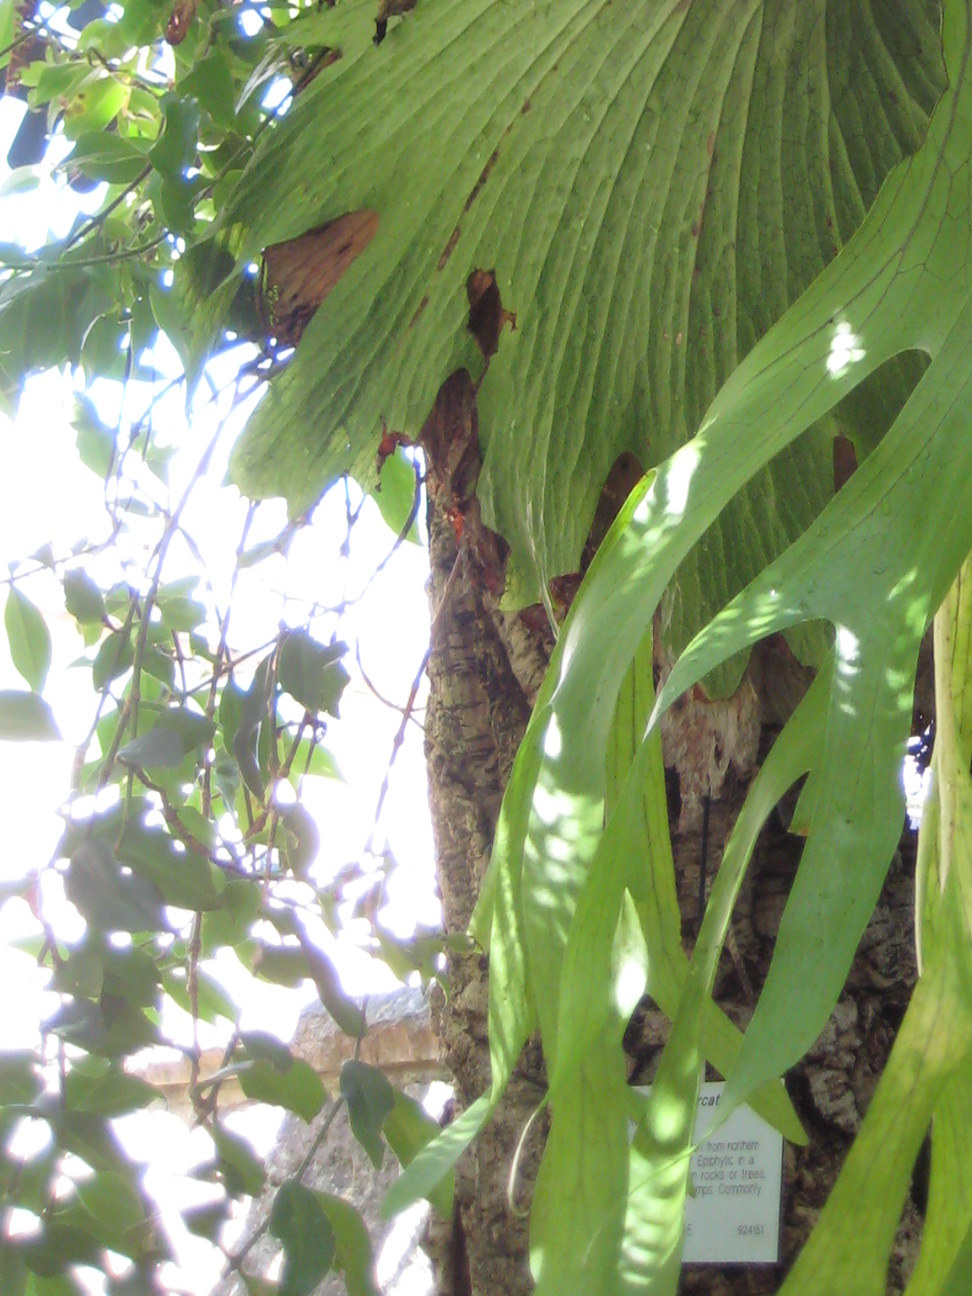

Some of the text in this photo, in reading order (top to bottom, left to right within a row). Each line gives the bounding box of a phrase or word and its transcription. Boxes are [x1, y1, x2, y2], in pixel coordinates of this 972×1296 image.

[698, 1094, 721, 1107] rcat
[707, 1141, 724, 1152] from
[727, 1140, 760, 1151] northern
[697, 1154, 734, 1168] Epiphytic
[700, 1170, 725, 1181] rocks
[728, 1170, 738, 1180] or
[718, 1182, 762, 1196] Commonly
